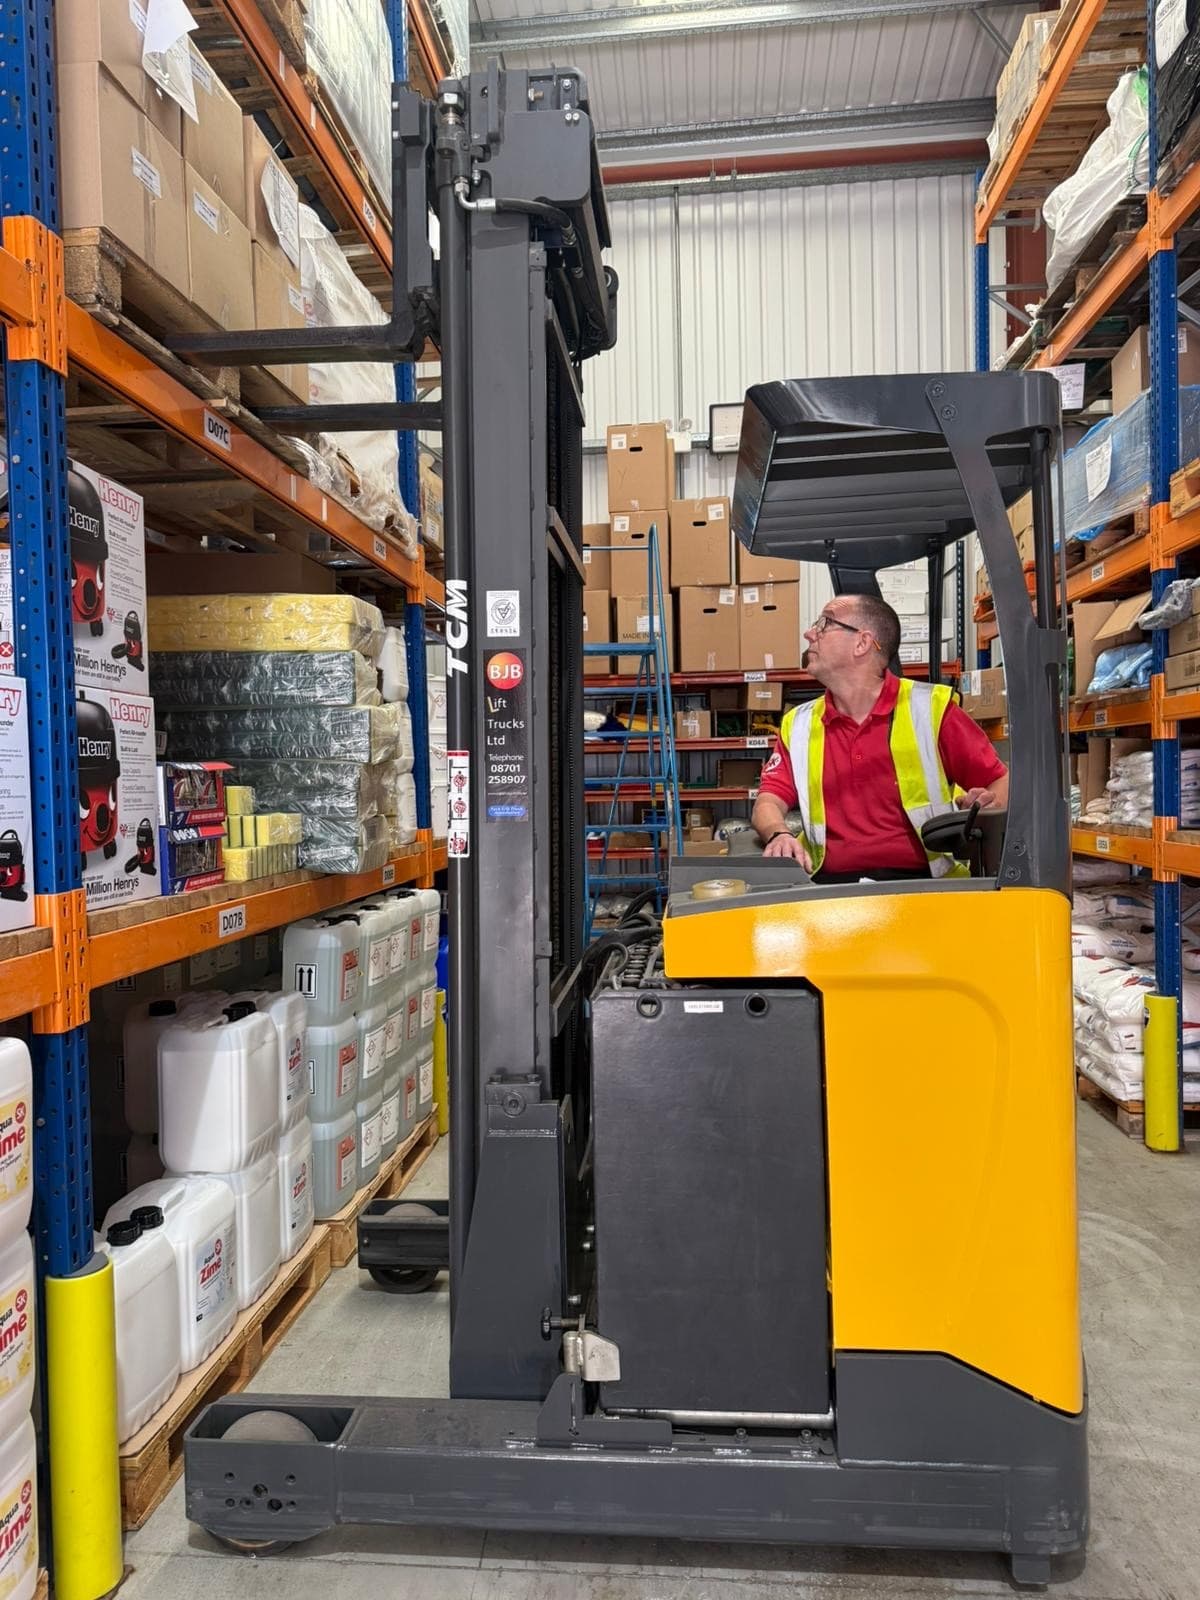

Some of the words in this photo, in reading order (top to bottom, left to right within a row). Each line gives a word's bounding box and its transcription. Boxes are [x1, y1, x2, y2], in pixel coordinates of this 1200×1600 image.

[208, 417, 229, 445] D07C
[98, 478, 139, 522] Henry
[446, 580, 468, 678] TCM
[623, 632, 641, 640] MADE
[101, 659, 126, 677] Henrys
[490, 663, 521, 679] BJB
[110, 697, 151, 728] Henry
[487, 696, 507, 713] Lift
[487, 719, 525, 729] Trucks
[79, 737, 112, 759] Henry
[487, 735, 506, 746] Ltd
[488, 753, 525, 762] Telephone
[490, 764, 521, 773] 08701
[488, 775, 526, 785] 258907
[86, 881, 112, 897] Million
[113, 877, 140, 892] Henrys
[223, 911, 243, 931] D07B
[200, 1257, 222, 1284] Zime
[0, 1313, 27, 1352] ime
